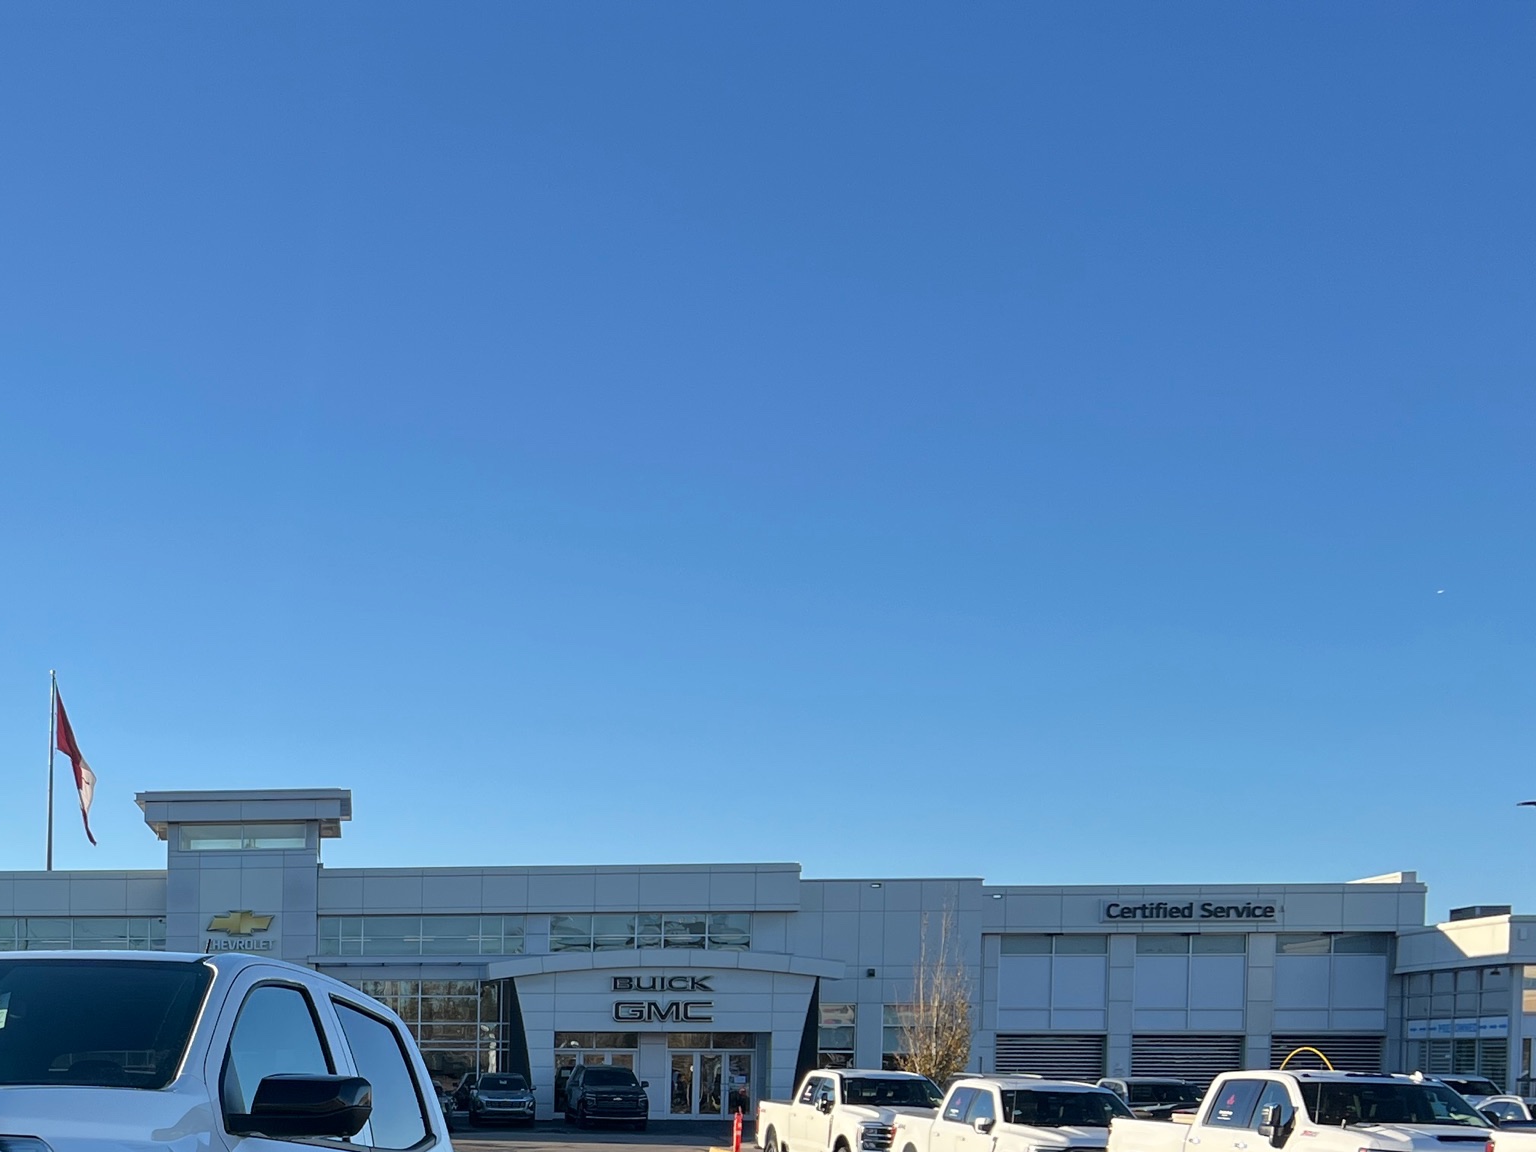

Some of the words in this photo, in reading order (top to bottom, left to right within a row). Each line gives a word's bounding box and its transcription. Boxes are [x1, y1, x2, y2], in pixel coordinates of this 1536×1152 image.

[1106, 902, 1193, 919] Certified
[1199, 902, 1275, 919] Service
[611, 976, 715, 992] BUICK
[612, 1000, 714, 1023] GMC
